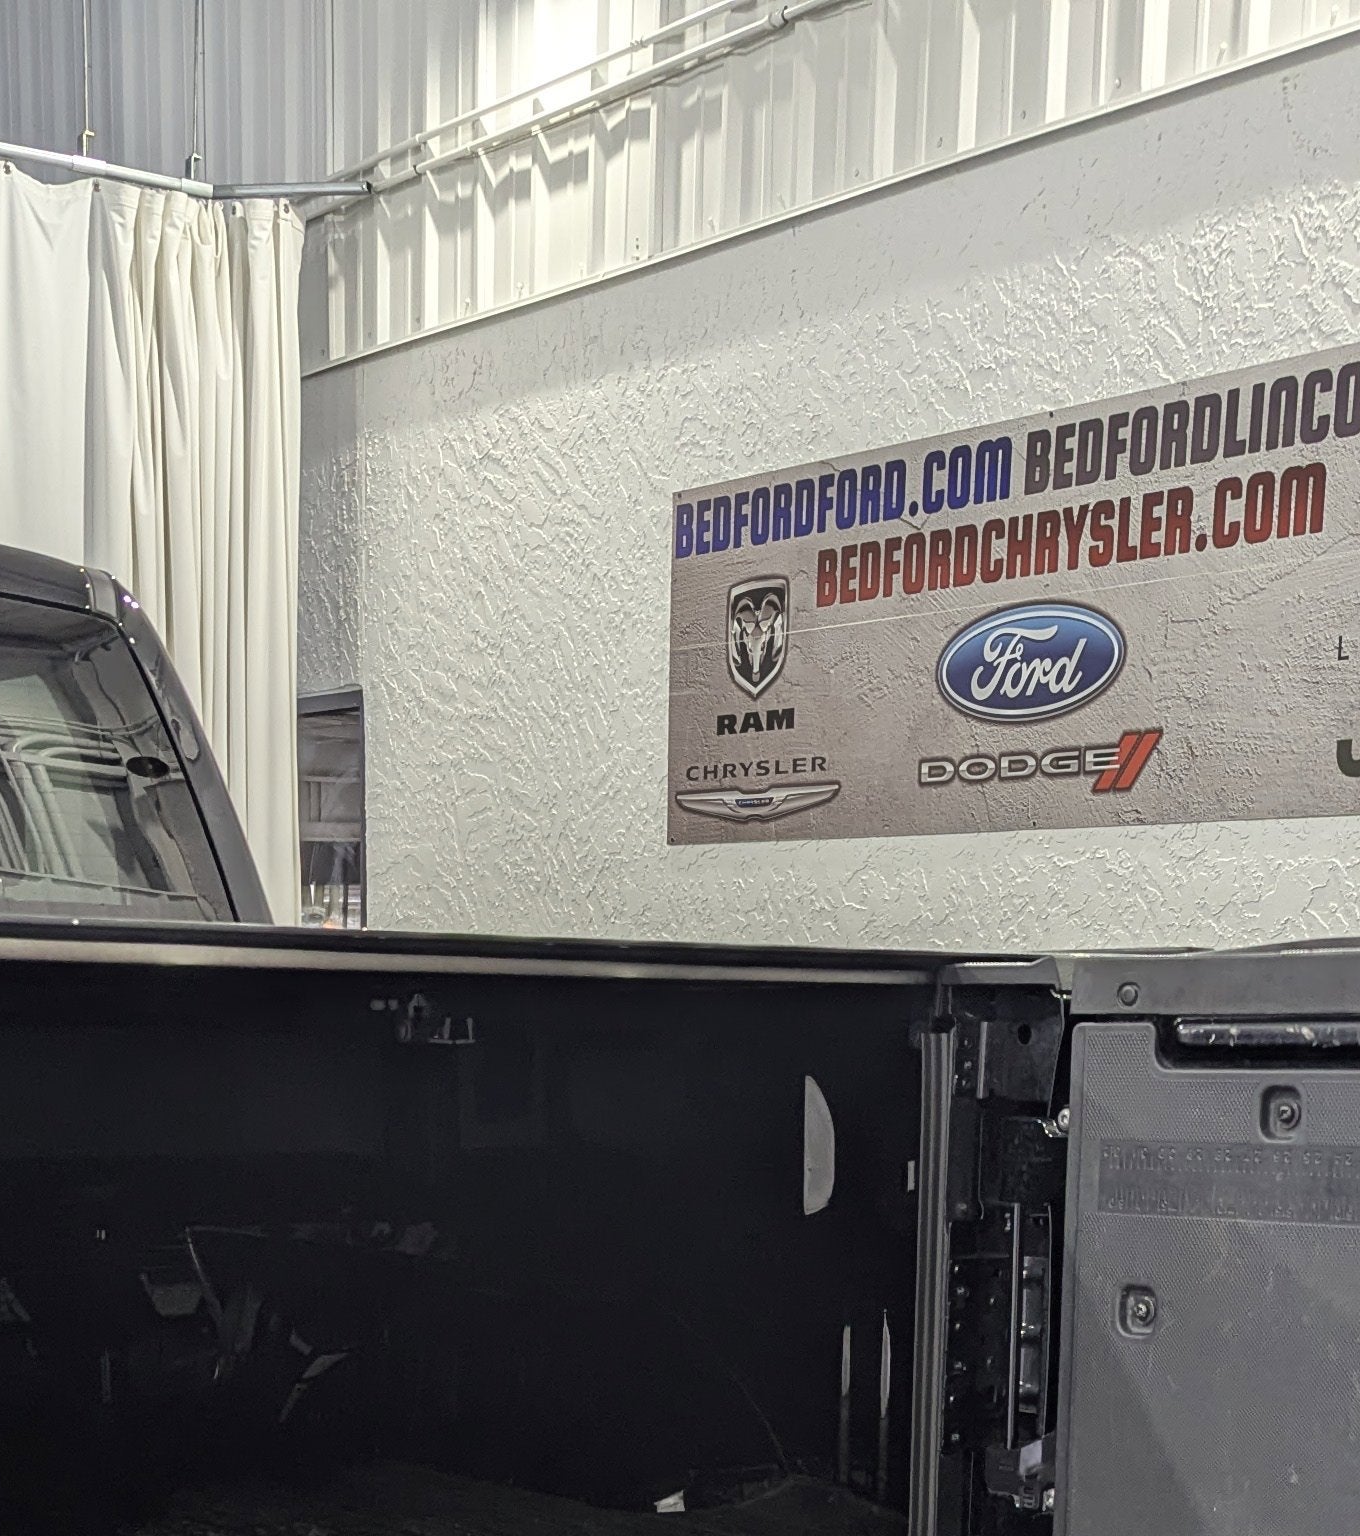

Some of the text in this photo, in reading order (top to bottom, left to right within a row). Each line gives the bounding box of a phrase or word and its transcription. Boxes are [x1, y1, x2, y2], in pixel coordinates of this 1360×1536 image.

[675, 437, 1013, 559] BEDFORDFORD.COM
[816, 462, 1327, 608] BEDFORDCHRYSLER.COM
[970, 625, 1089, 699] Ford
[715, 707, 796, 736] RAM
[686, 756, 828, 782] CHRYSLER
[919, 744, 1122, 787] DODGE
